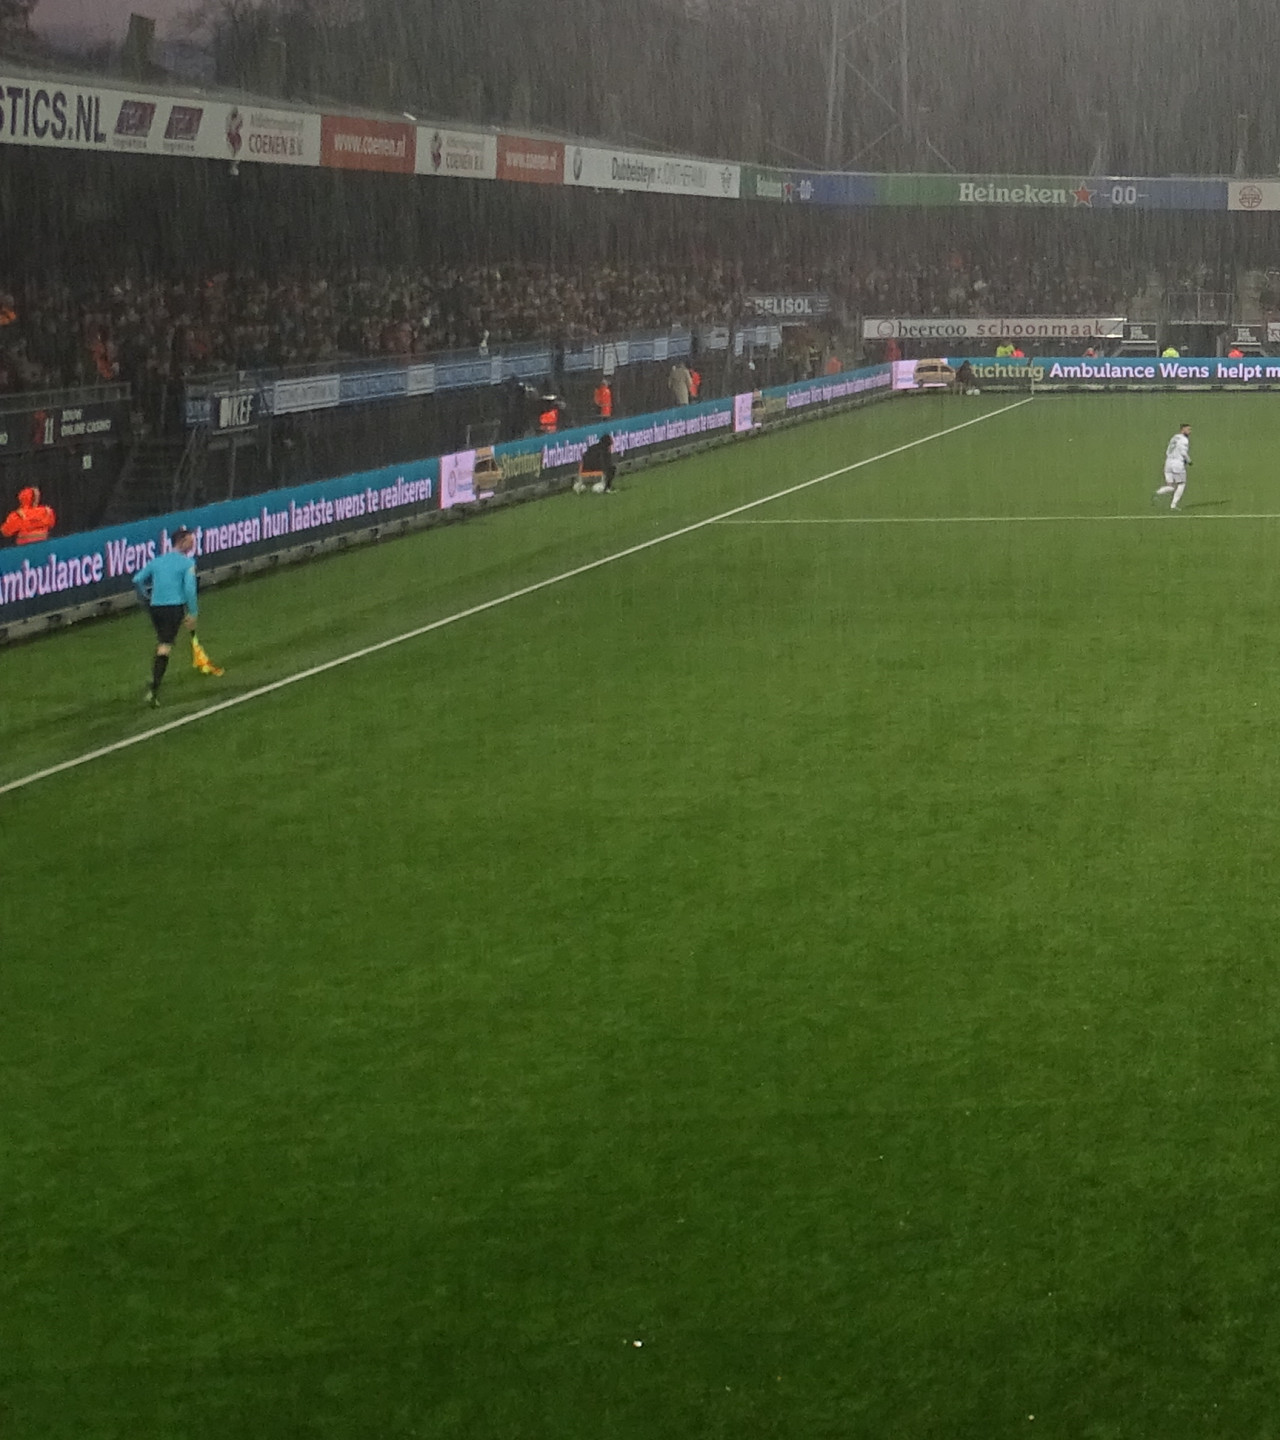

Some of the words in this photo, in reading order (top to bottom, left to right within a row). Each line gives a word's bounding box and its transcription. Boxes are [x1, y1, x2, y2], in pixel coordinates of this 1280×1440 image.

[0, 87, 107, 143] TICS.NL
[249, 133, 288, 156] COENEN
[958, 183, 1067, 204] Heineken
[976, 319, 1105, 337] schoonmaak
[969, 363, 1044, 381] tichting
[1050, 362, 1155, 379] Ambulance
[1159, 362, 1210, 379] Wens
[1217, 362, 1266, 382] helpt
[0, 553, 103, 606] mbulance
[106, 536, 156, 577] Wens
[204, 516, 261, 554] mensen
[262, 506, 290, 540] hun
[290, 497, 334, 532] laatste
[334, 495, 365, 520] wens
[366, 487, 380, 509] te
[380, 476, 432, 511] realiseren
